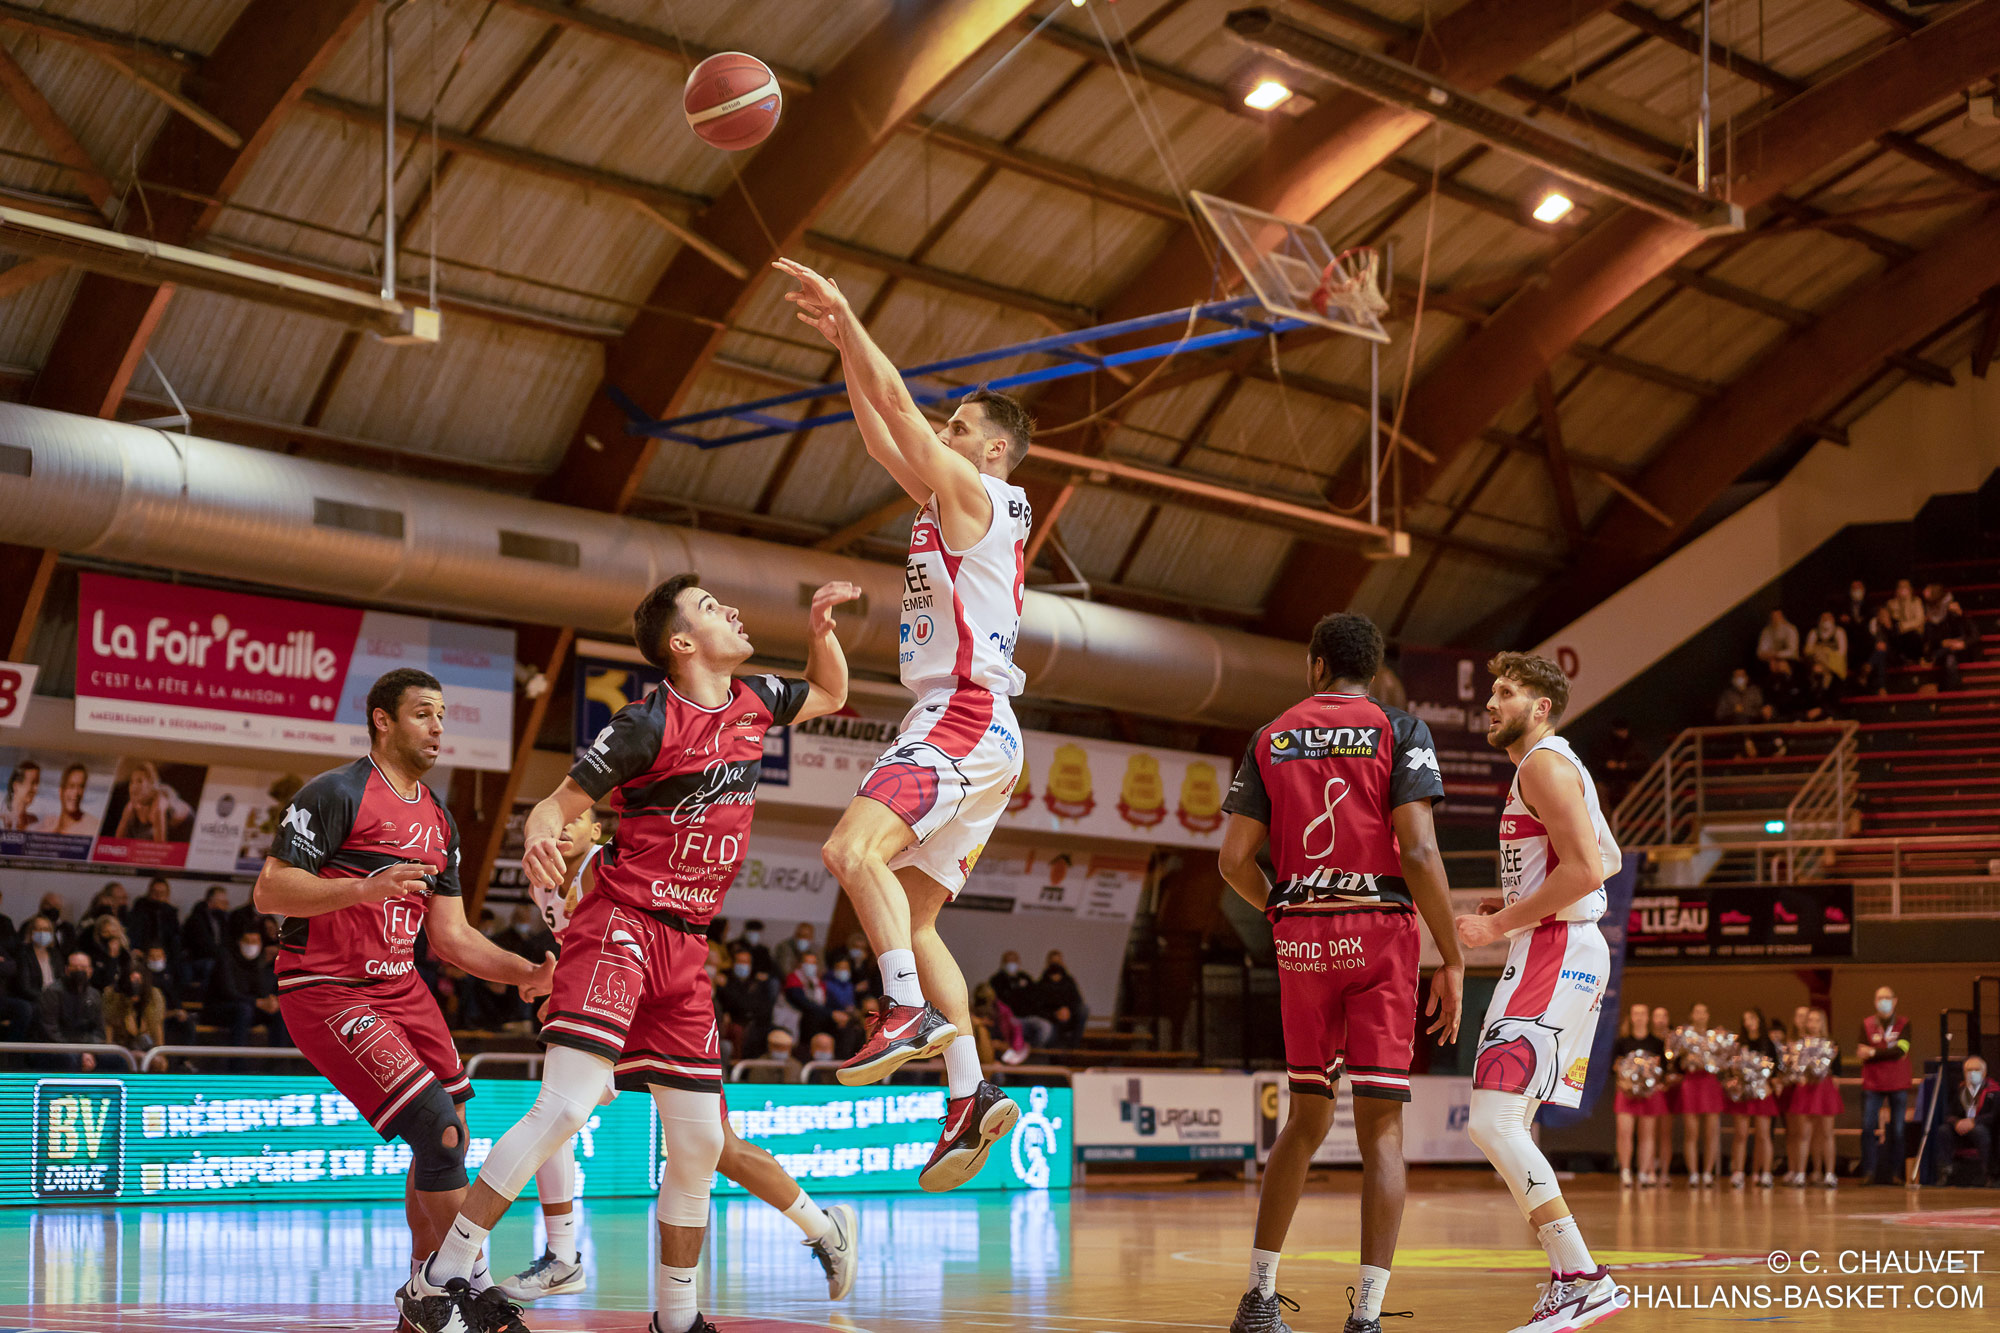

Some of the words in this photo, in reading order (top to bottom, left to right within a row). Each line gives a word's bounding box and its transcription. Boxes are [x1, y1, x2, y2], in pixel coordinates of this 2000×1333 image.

[901, 595, 934, 612] EMENT
[92, 609, 138, 660] La
[91, 669, 130, 687] C'EST
[135, 677, 153, 691] LA
[158, 675, 189, 695] FÊTE
[209, 684, 227, 699] LA
[231, 687, 285, 704] MAISON
[1304, 748, 1329, 757] votre
[1302, 777, 1351, 859] 8
[400, 821, 433, 854] 21
[1328, 936, 1364, 957] DAX
[1561, 969, 1597, 985] HYPER
[47, 1095, 111, 1159] BV
